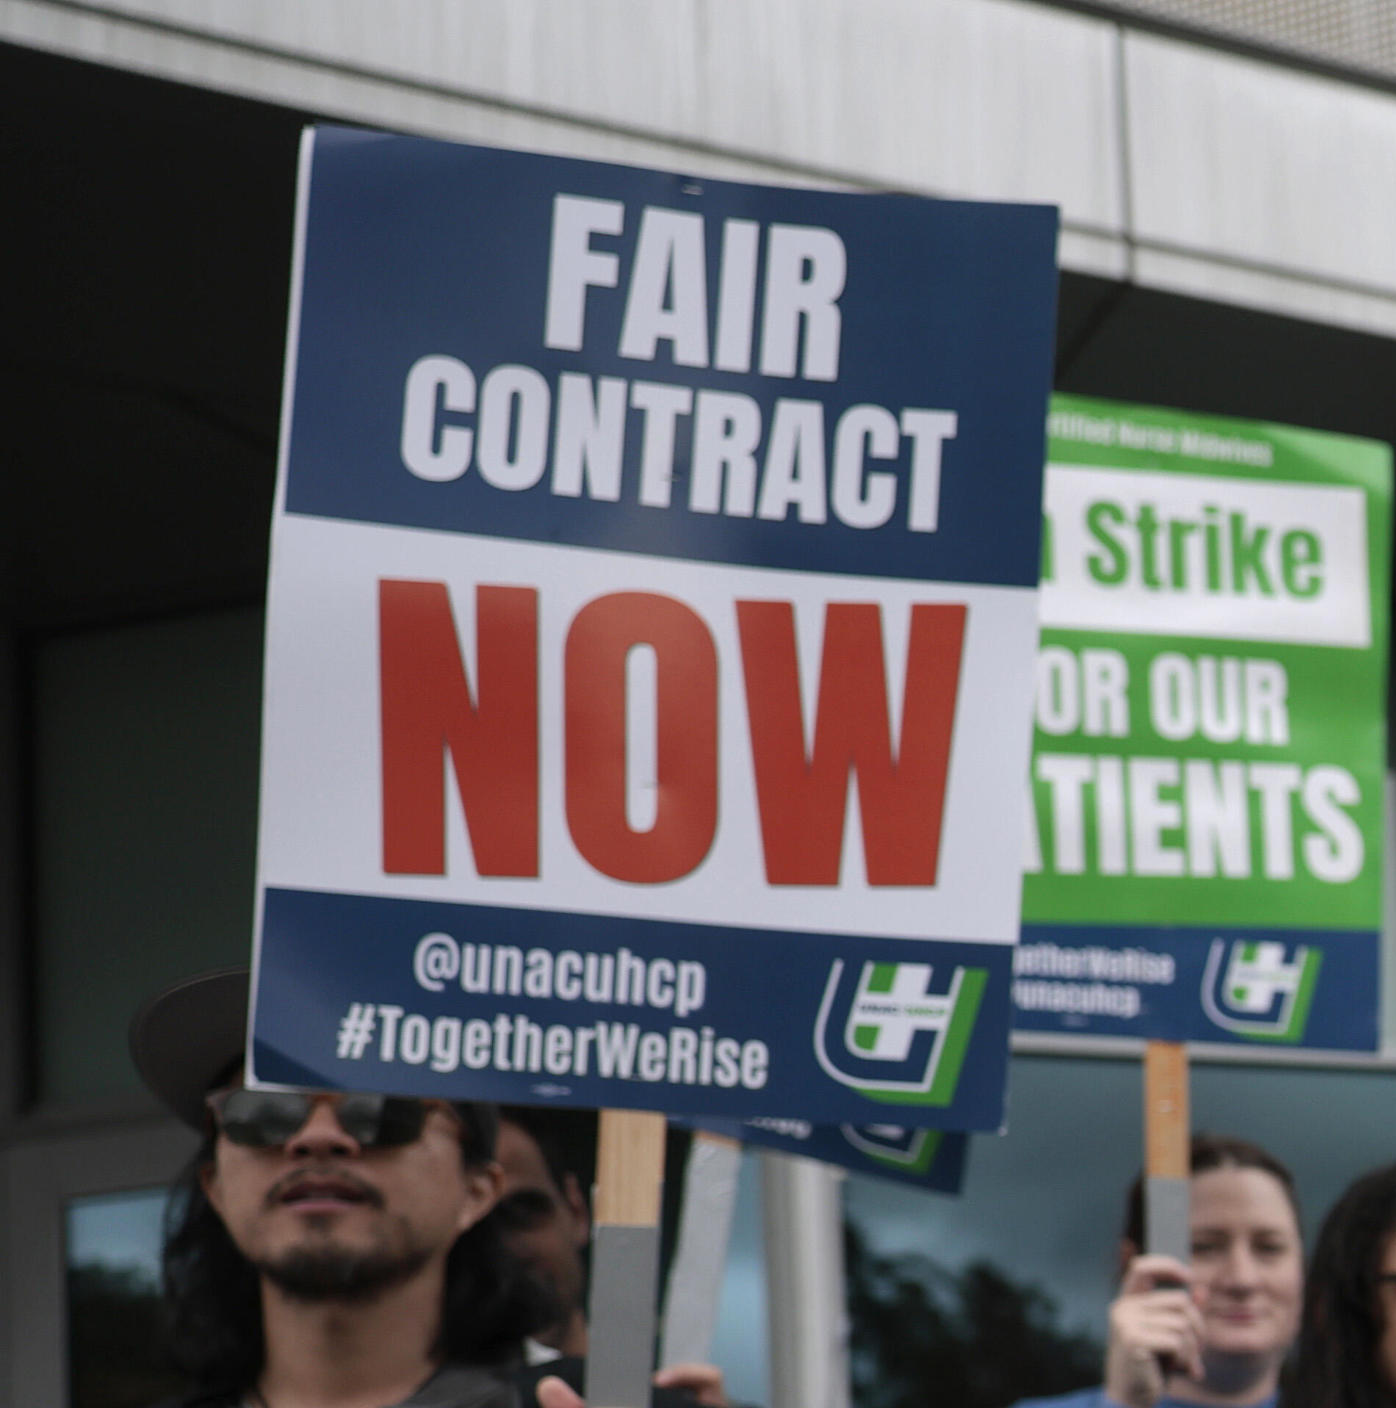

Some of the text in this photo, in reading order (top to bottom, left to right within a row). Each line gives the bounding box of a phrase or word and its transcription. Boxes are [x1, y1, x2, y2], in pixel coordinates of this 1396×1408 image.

[544, 192, 848, 382] FAIR
[400, 354, 957, 533] CONTRACT
[1085, 499, 1325, 603] Strike
[378, 577, 970, 889] NOW
[1035, 645, 1291, 747] OR OUR
[412, 931, 707, 1019] @unacuhcp
[337, 1003, 769, 1090] #TogetherWeRise
